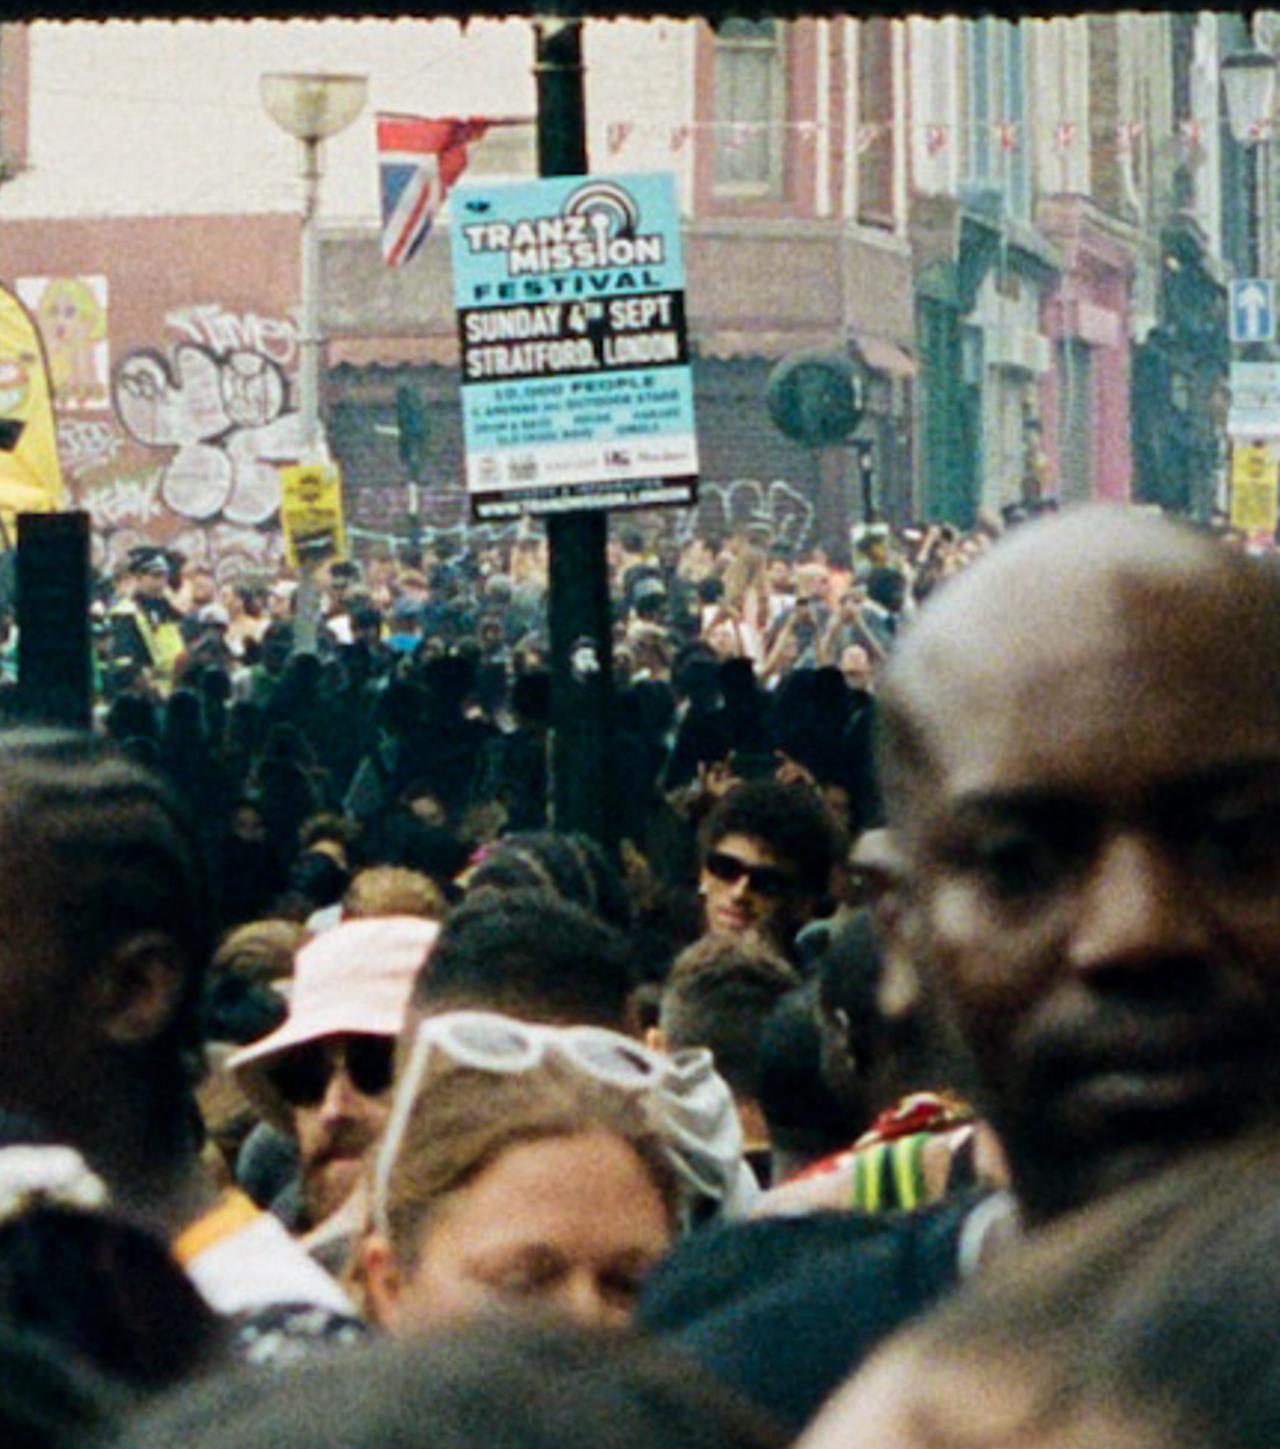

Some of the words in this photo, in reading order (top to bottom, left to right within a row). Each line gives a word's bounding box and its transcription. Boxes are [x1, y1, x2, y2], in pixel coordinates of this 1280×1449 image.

[464, 214, 587, 253] TRANZ
[509, 217, 663, 276] MISSION
[473, 270, 662, 300] FESTIVAL
[465, 305, 561, 344] SUNDAY
[609, 295, 673, 331] SEPT
